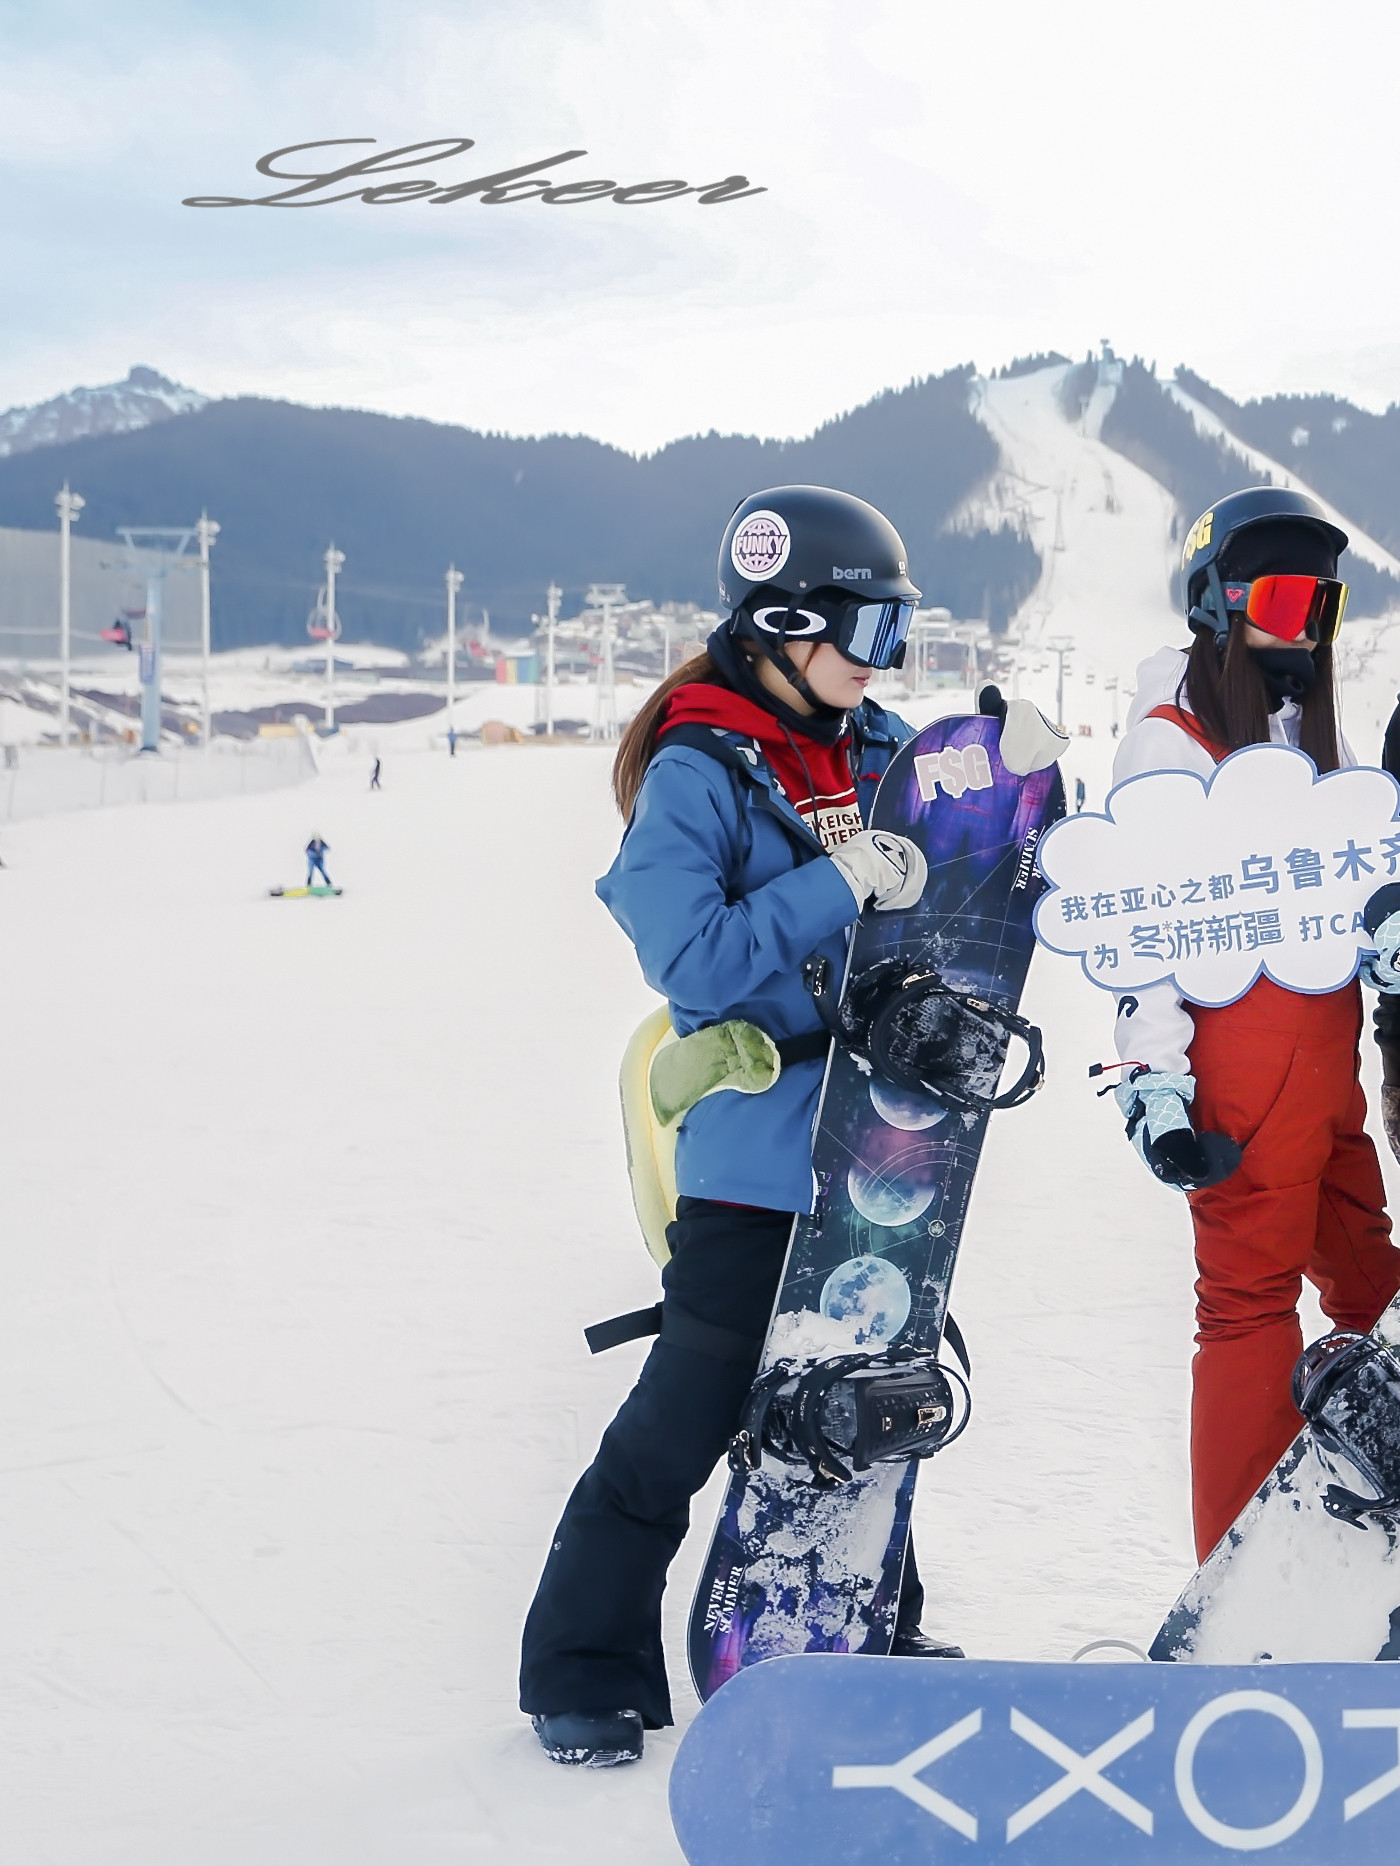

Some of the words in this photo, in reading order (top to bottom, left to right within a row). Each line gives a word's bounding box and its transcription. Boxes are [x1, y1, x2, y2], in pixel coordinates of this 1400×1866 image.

[734, 534, 787, 556] FUNKY
[832, 566, 872, 580] bern
[703, 1577, 726, 1632] NEVER
[718, 1565, 744, 1635] SUMMER
